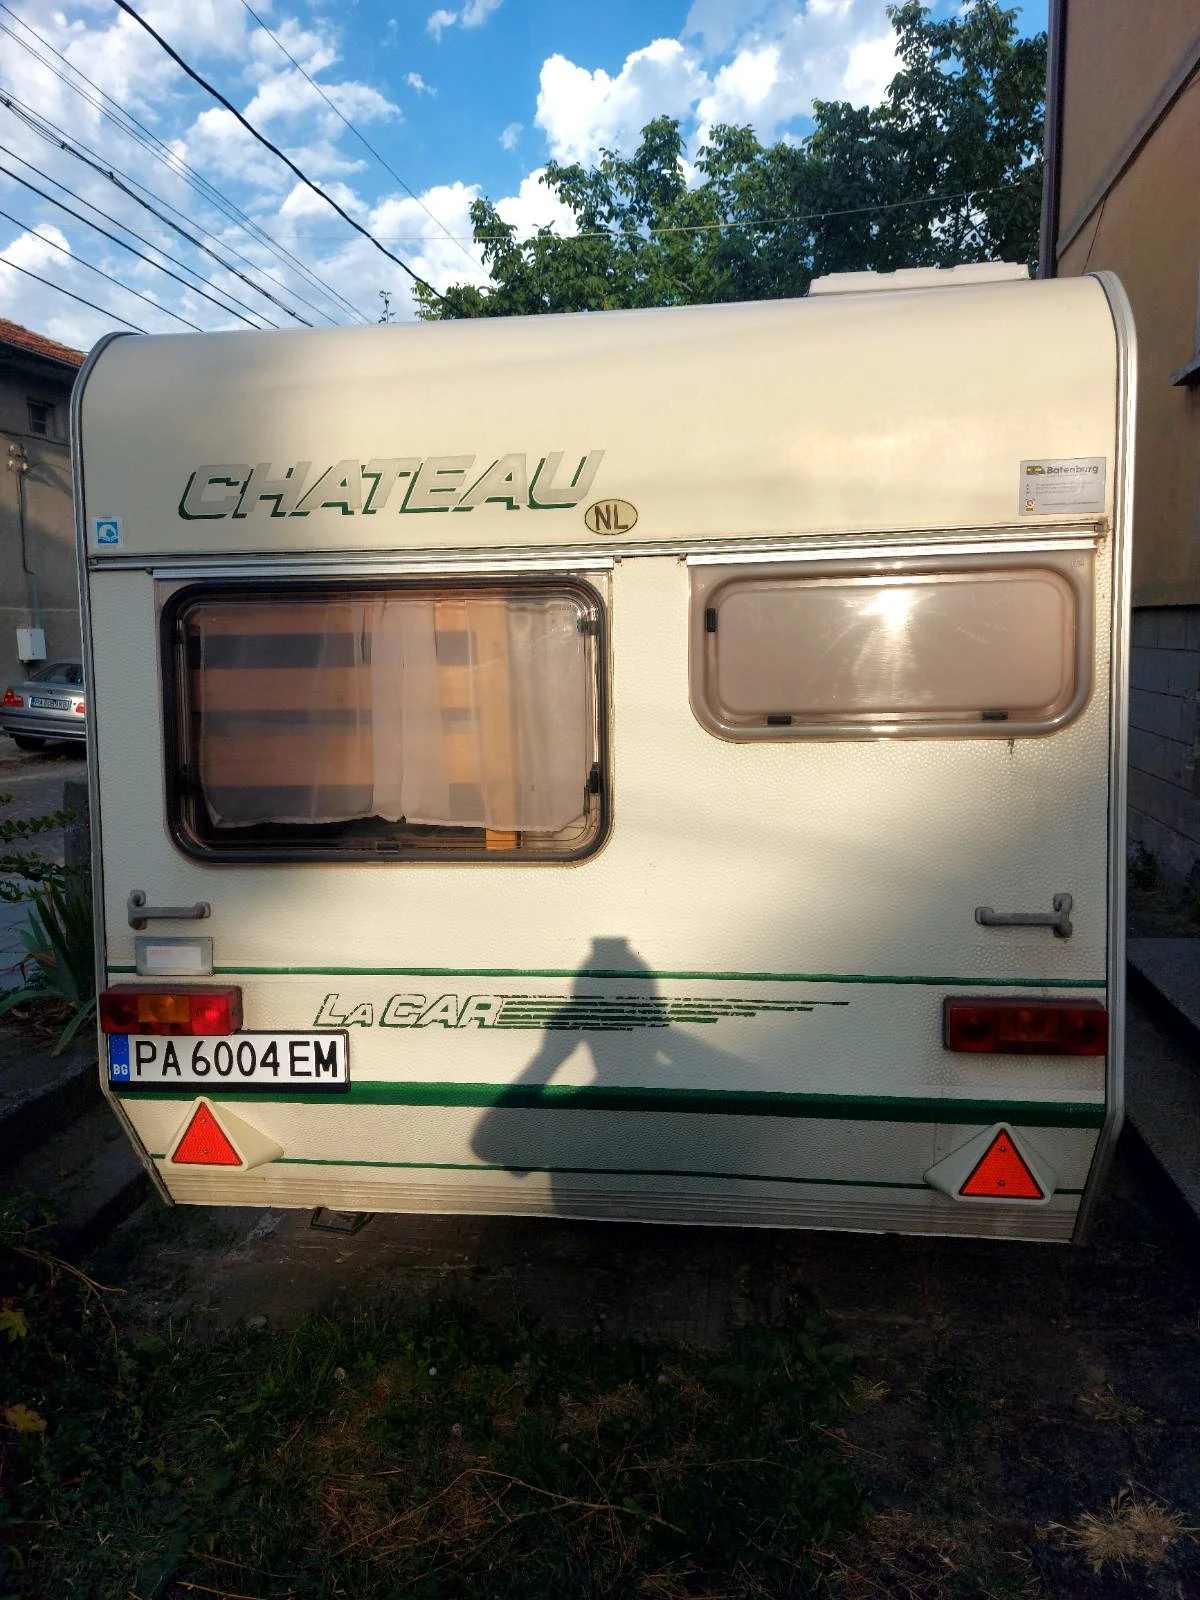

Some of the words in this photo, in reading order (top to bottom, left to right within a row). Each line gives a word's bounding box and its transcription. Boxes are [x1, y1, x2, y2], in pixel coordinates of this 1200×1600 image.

[1046, 465, 1099, 475] Batenburg
[178, 450, 606, 520] CHATEAU
[595, 504, 629, 530] NL
[113, 1063, 129, 1075] BG
